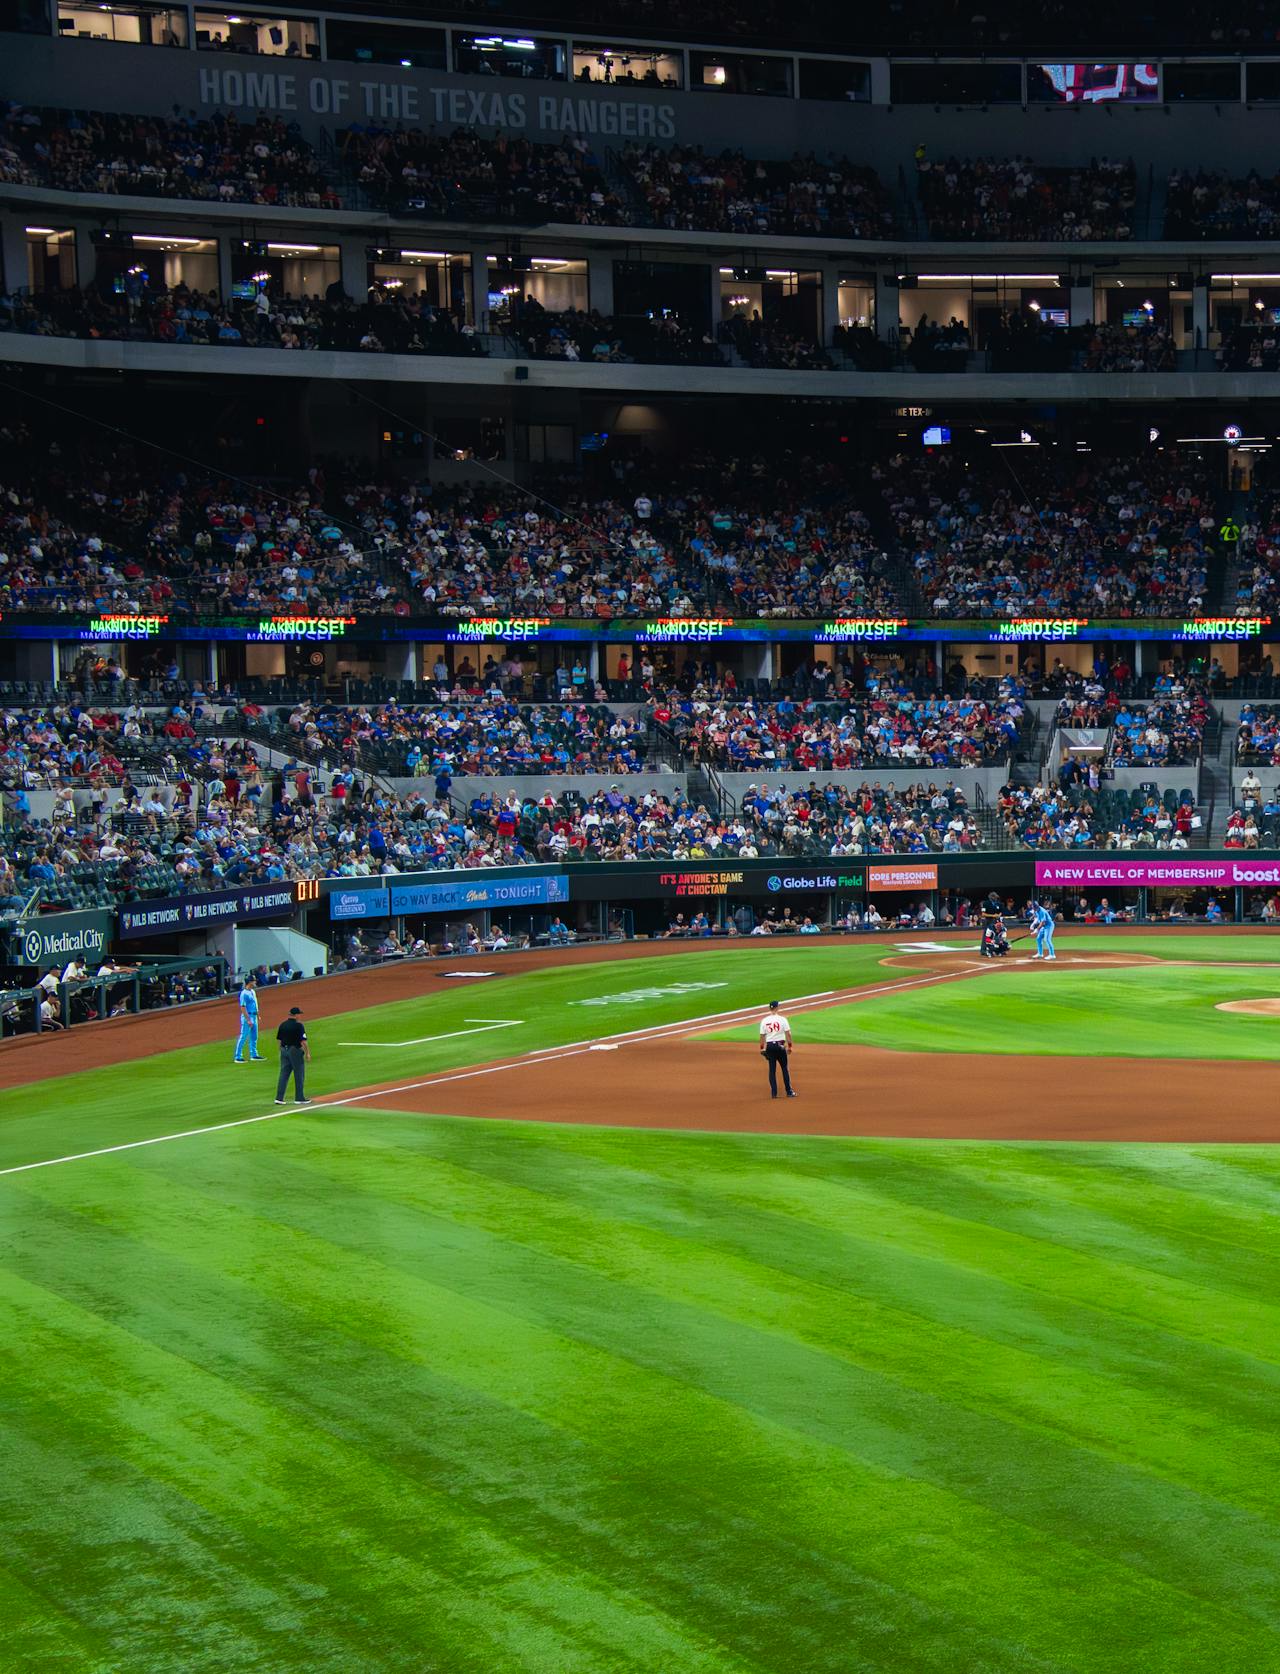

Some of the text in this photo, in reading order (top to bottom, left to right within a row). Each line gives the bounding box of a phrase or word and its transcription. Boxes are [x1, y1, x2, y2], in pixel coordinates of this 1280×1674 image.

[200, 68, 677, 139] HOME OF THE TEXAS RANGERS
[659, 872, 744, 885] IT'S ANYONE'S GAME
[783, 875, 863, 888] Globe Life Field
[869, 871, 937, 881] CORE PERSONNEL
[1042, 868, 1053, 879] A
[1055, 868, 1084, 879] NEW
[1087, 868, 1125, 879] LEVEL
[1127, 868, 1145, 879] OF
[1147, 868, 1226, 880] MEMBERSHIP
[392, 896, 408, 908] GO
[409, 894, 432, 907] WAY
[494, 885, 543, 899] TONIGHT
[675, 884, 728, 896] AT CHOCTAW
[193, 900, 238, 919] MLB NETWORK
[251, 891, 292, 910] MLB NETWORK
[131, 907, 180, 927] MLB NETWORK
[44, 929, 105, 955] Medical City
